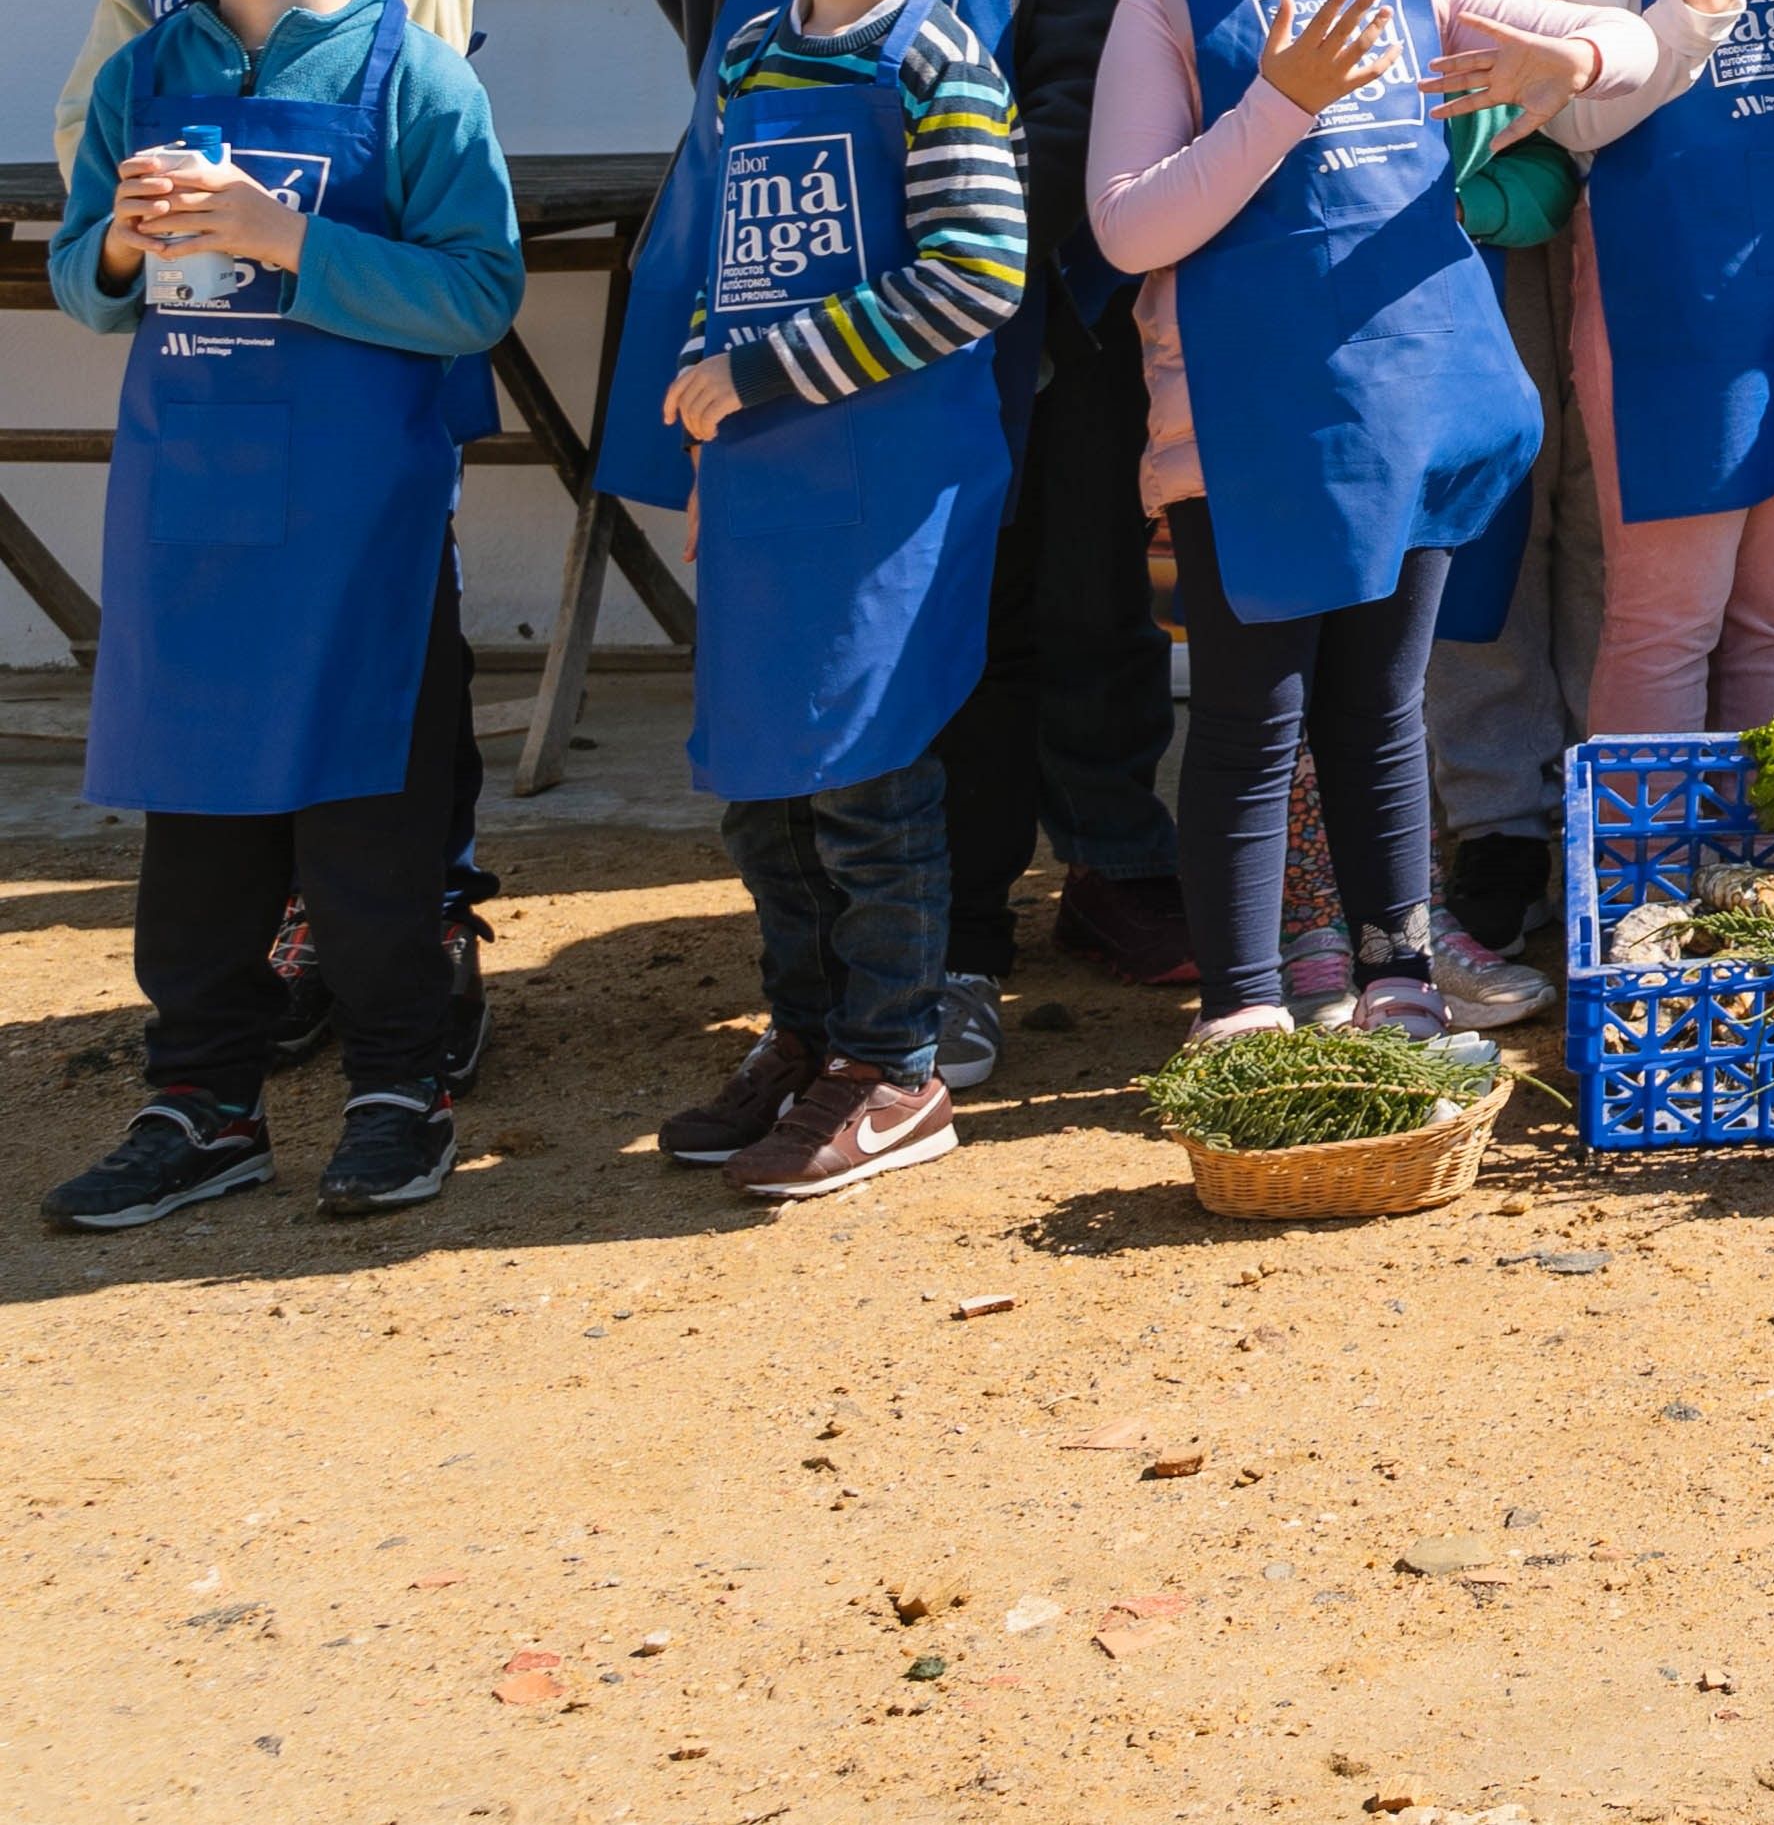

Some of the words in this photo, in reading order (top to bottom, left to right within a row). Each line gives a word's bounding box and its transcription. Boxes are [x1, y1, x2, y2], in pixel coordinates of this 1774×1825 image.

[730, 152, 770, 175] sabor
[739, 151, 847, 220] má
[723, 209, 852, 277] laga
